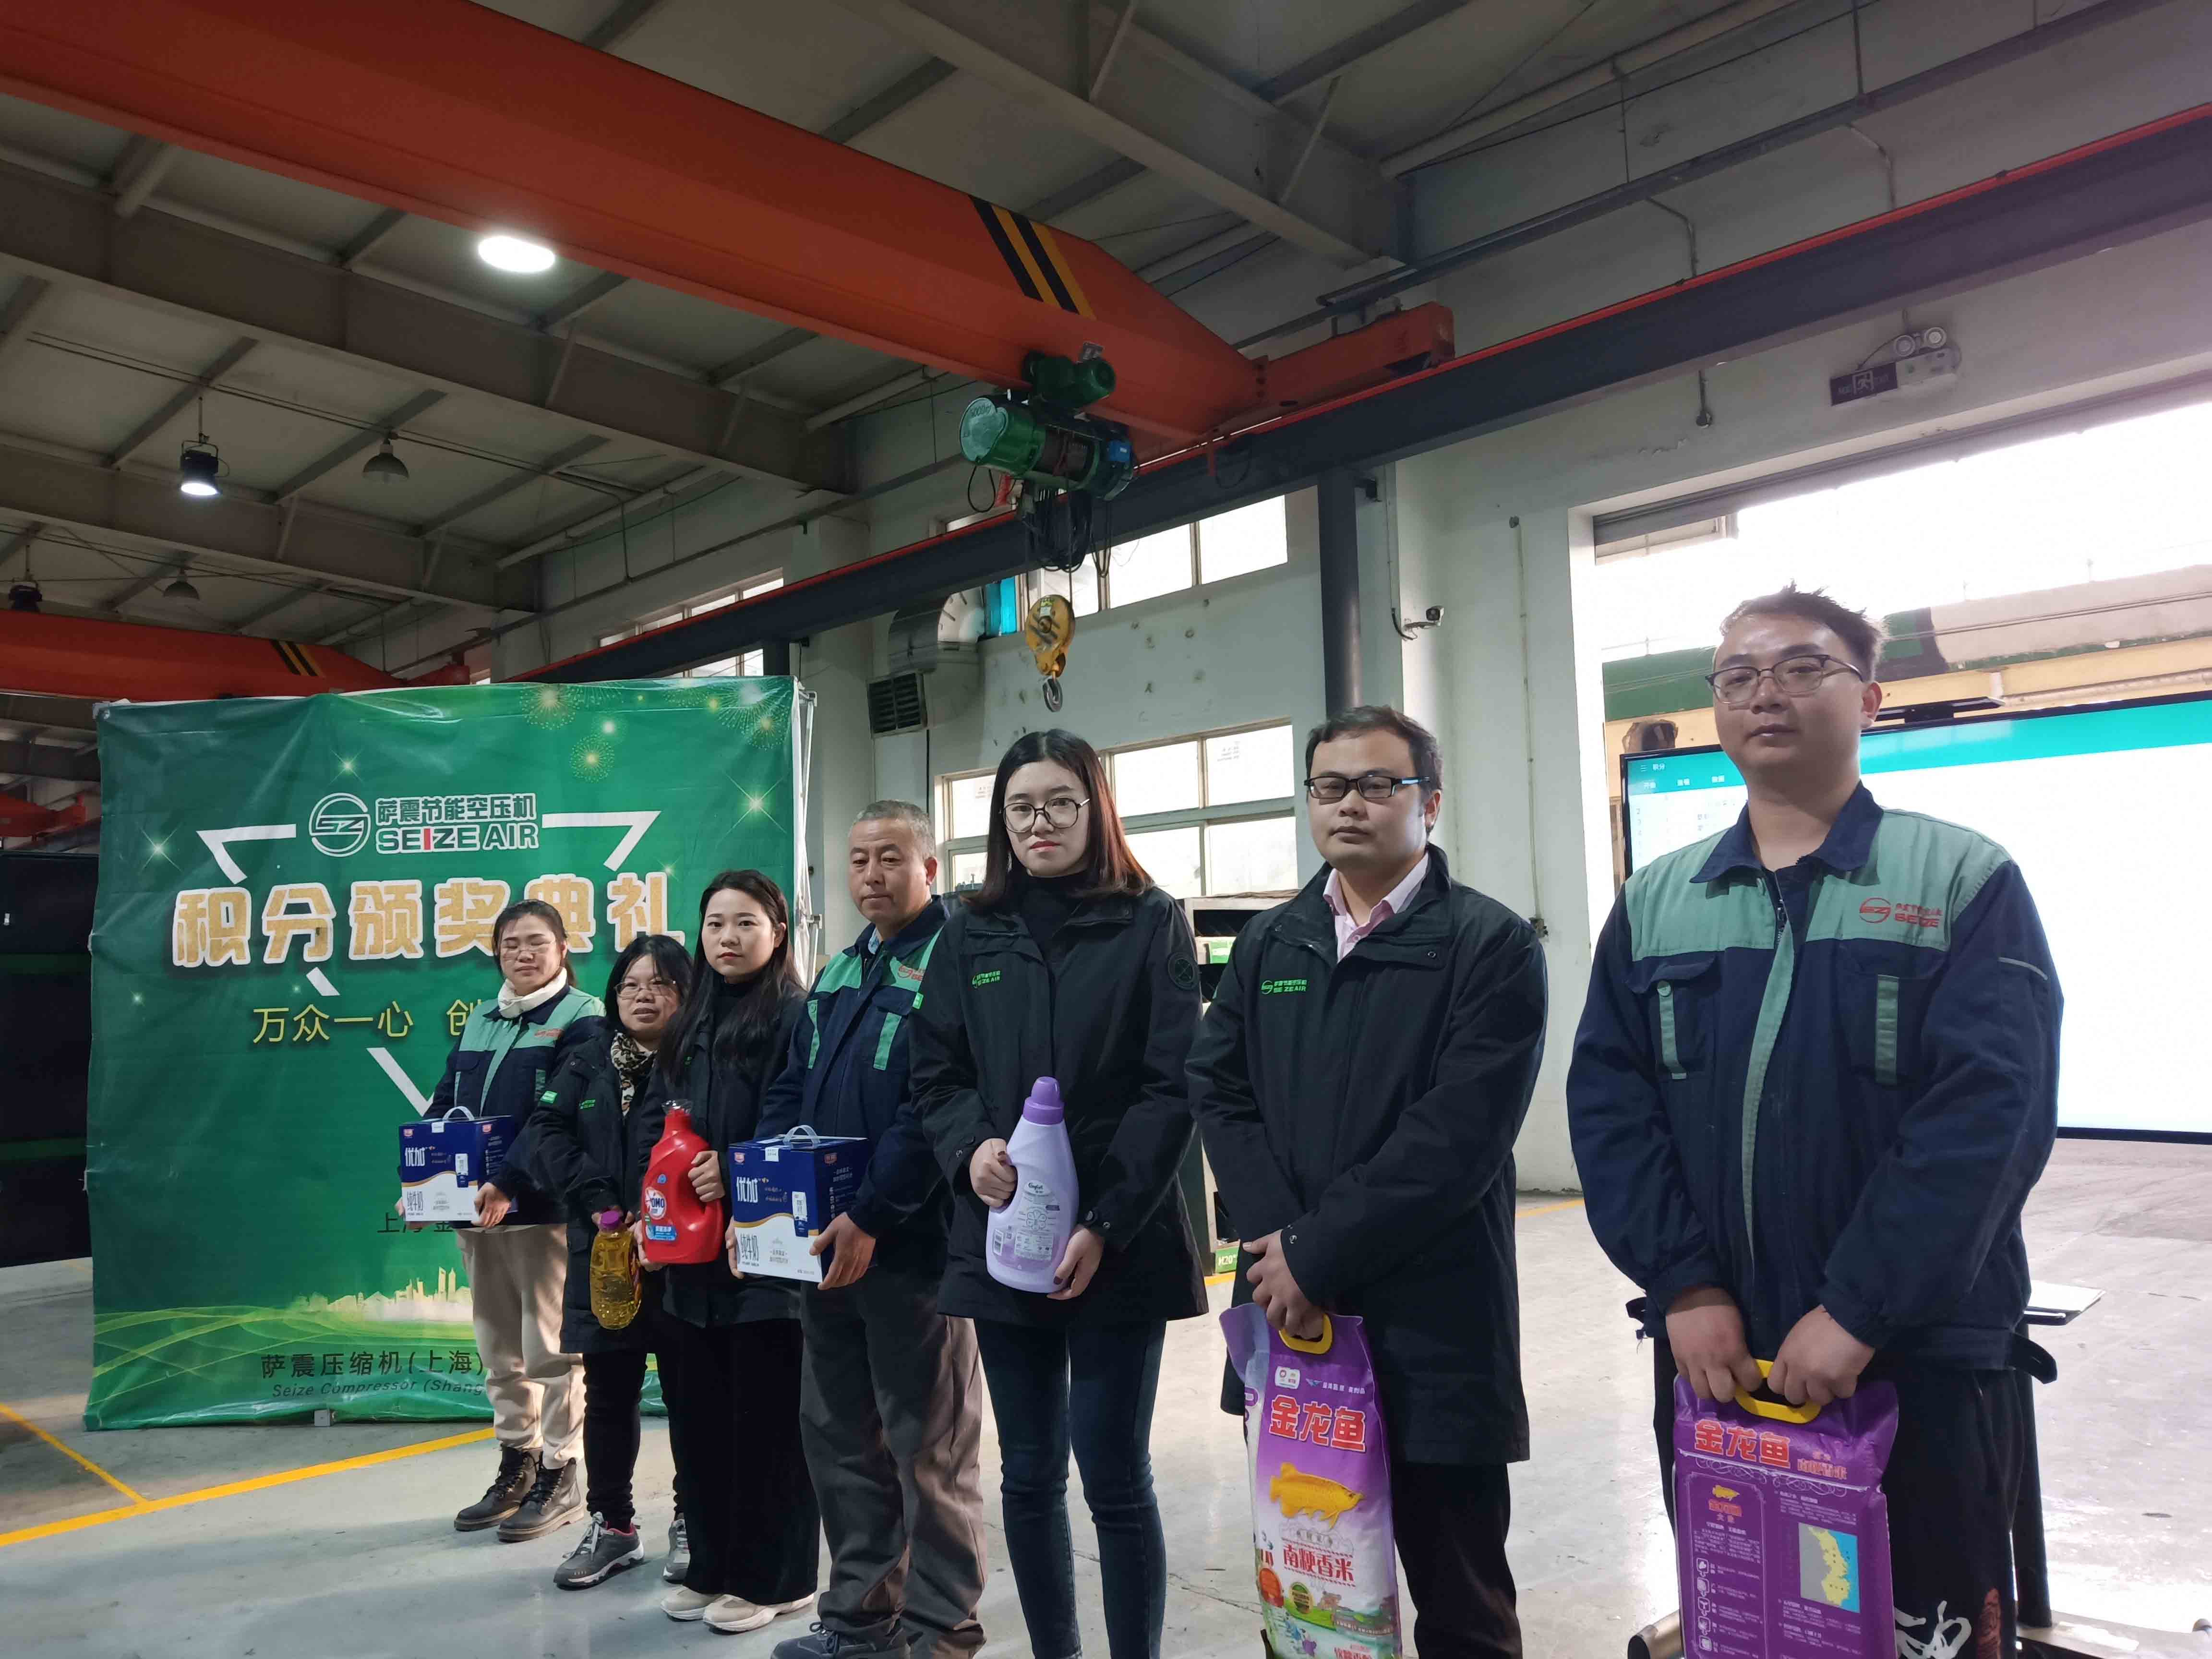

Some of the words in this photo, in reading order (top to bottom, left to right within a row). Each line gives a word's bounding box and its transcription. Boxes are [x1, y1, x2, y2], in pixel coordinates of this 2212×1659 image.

[377, 794, 535, 824] 萨震节能空压机
[377, 826, 480, 853] SEIZE
[484, 824, 538, 850] AIR
[173, 872, 685, 967] 积分颁奖典礼
[253, 1001, 414, 1043] 万众一心
[273, 1383, 314, 1398] Seize
[321, 1380, 416, 1395] Compressor
[1269, 1394, 1366, 1453] 金龙鱼
[1695, 1419, 1791, 1469] 金龙鱼
